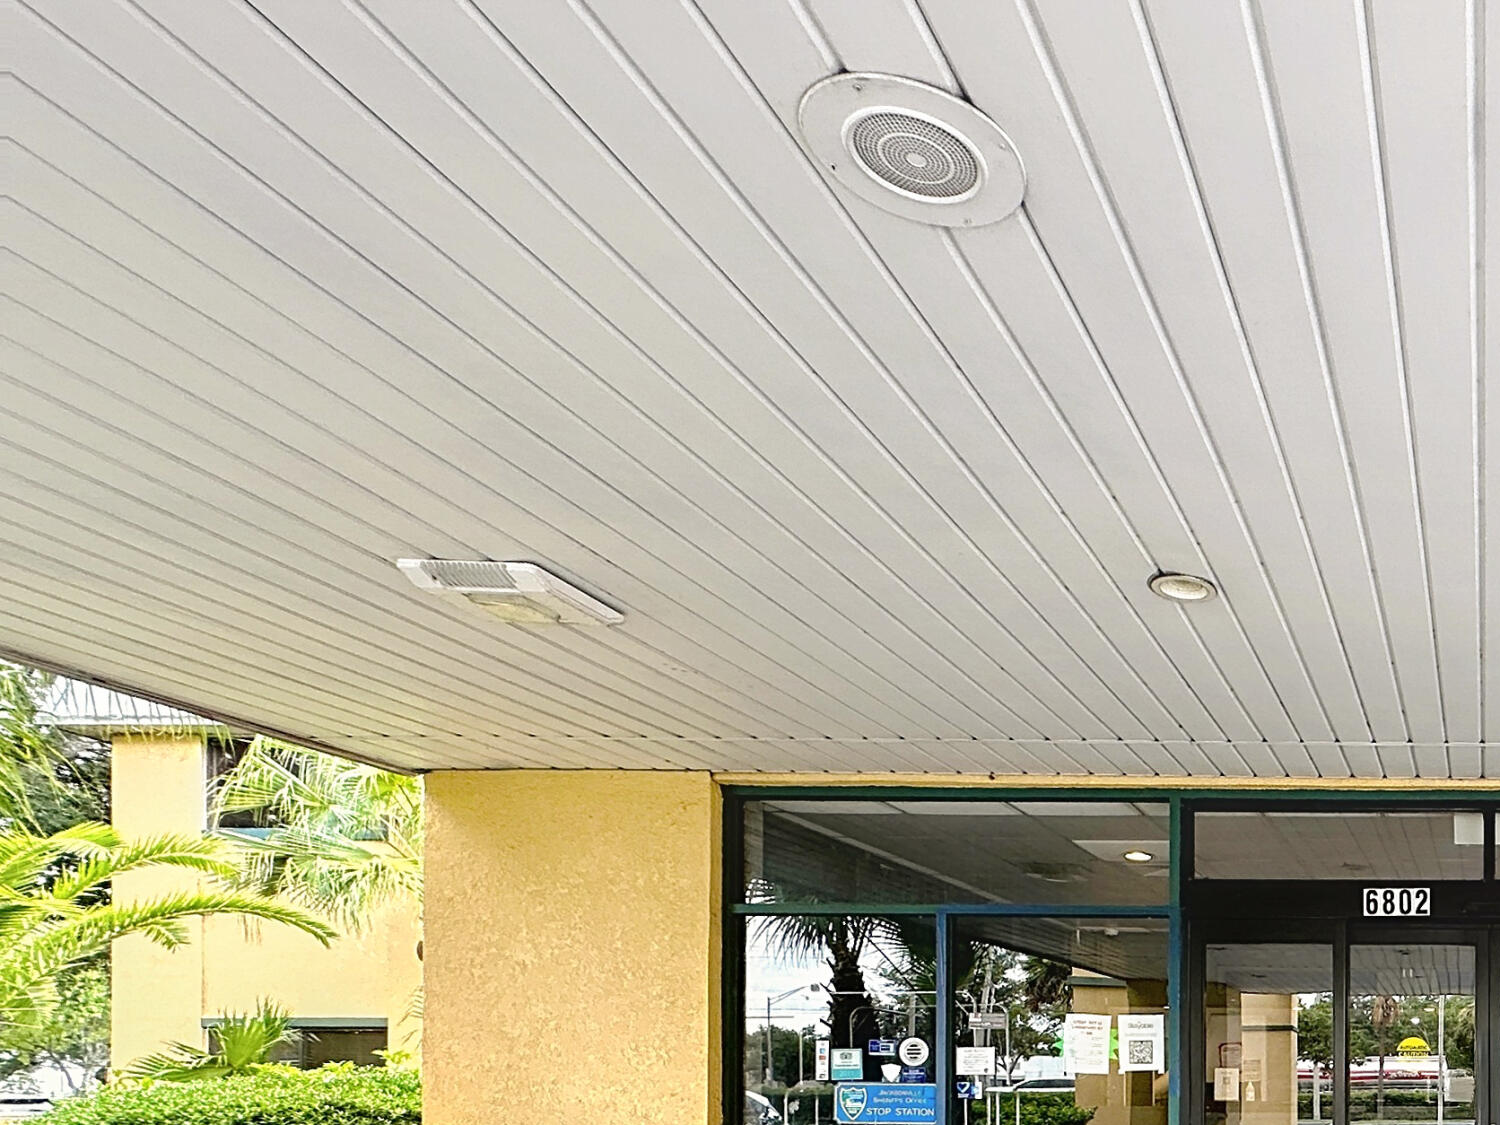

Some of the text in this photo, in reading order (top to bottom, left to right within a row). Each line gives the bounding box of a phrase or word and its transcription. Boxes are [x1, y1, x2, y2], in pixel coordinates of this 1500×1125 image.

[1366, 889, 1428, 915] 6802
[866, 1107, 935, 1117] STOP STATION
